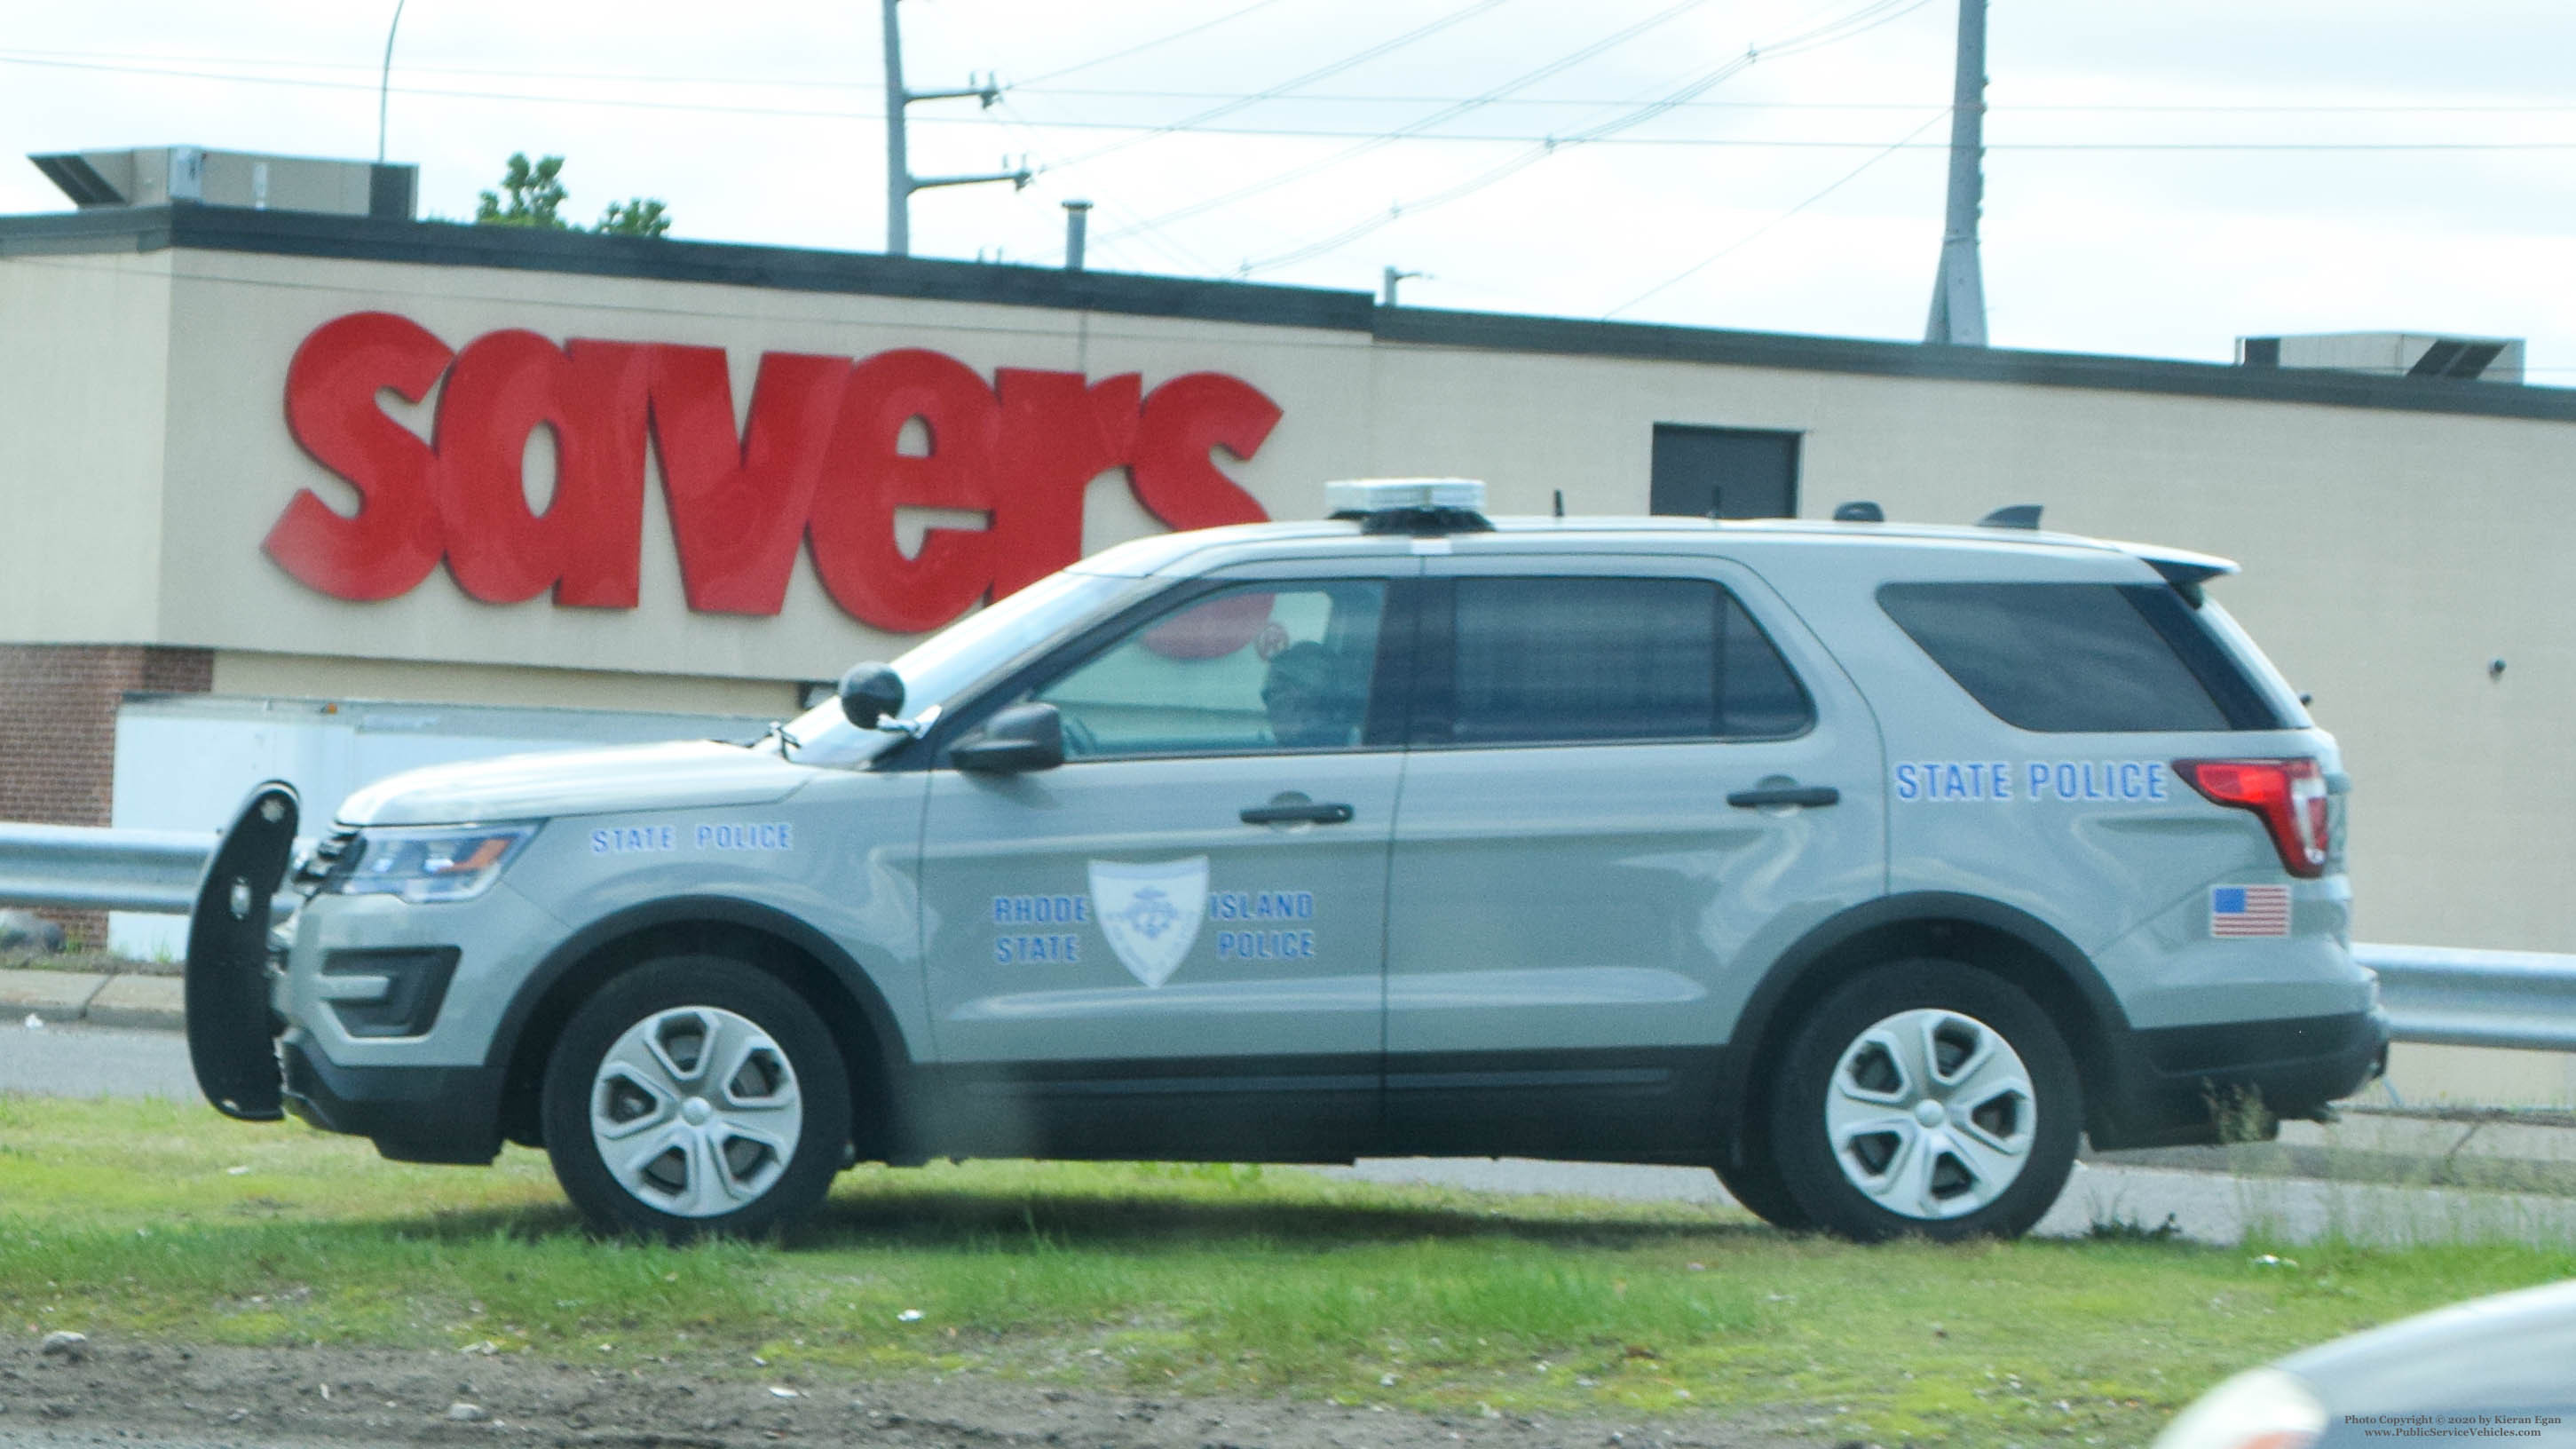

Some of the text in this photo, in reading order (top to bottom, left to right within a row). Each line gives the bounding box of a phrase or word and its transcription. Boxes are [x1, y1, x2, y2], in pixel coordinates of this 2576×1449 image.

[262, 311, 1284, 659] savers
[1896, 761, 2168, 800] STATE POLICE
[591, 822, 793, 853] STATE POLICE
[993, 891, 1314, 924] RHODE ISLAND
[994, 935, 1080, 963] STATE
[1216, 930, 1316, 960] POLICE
